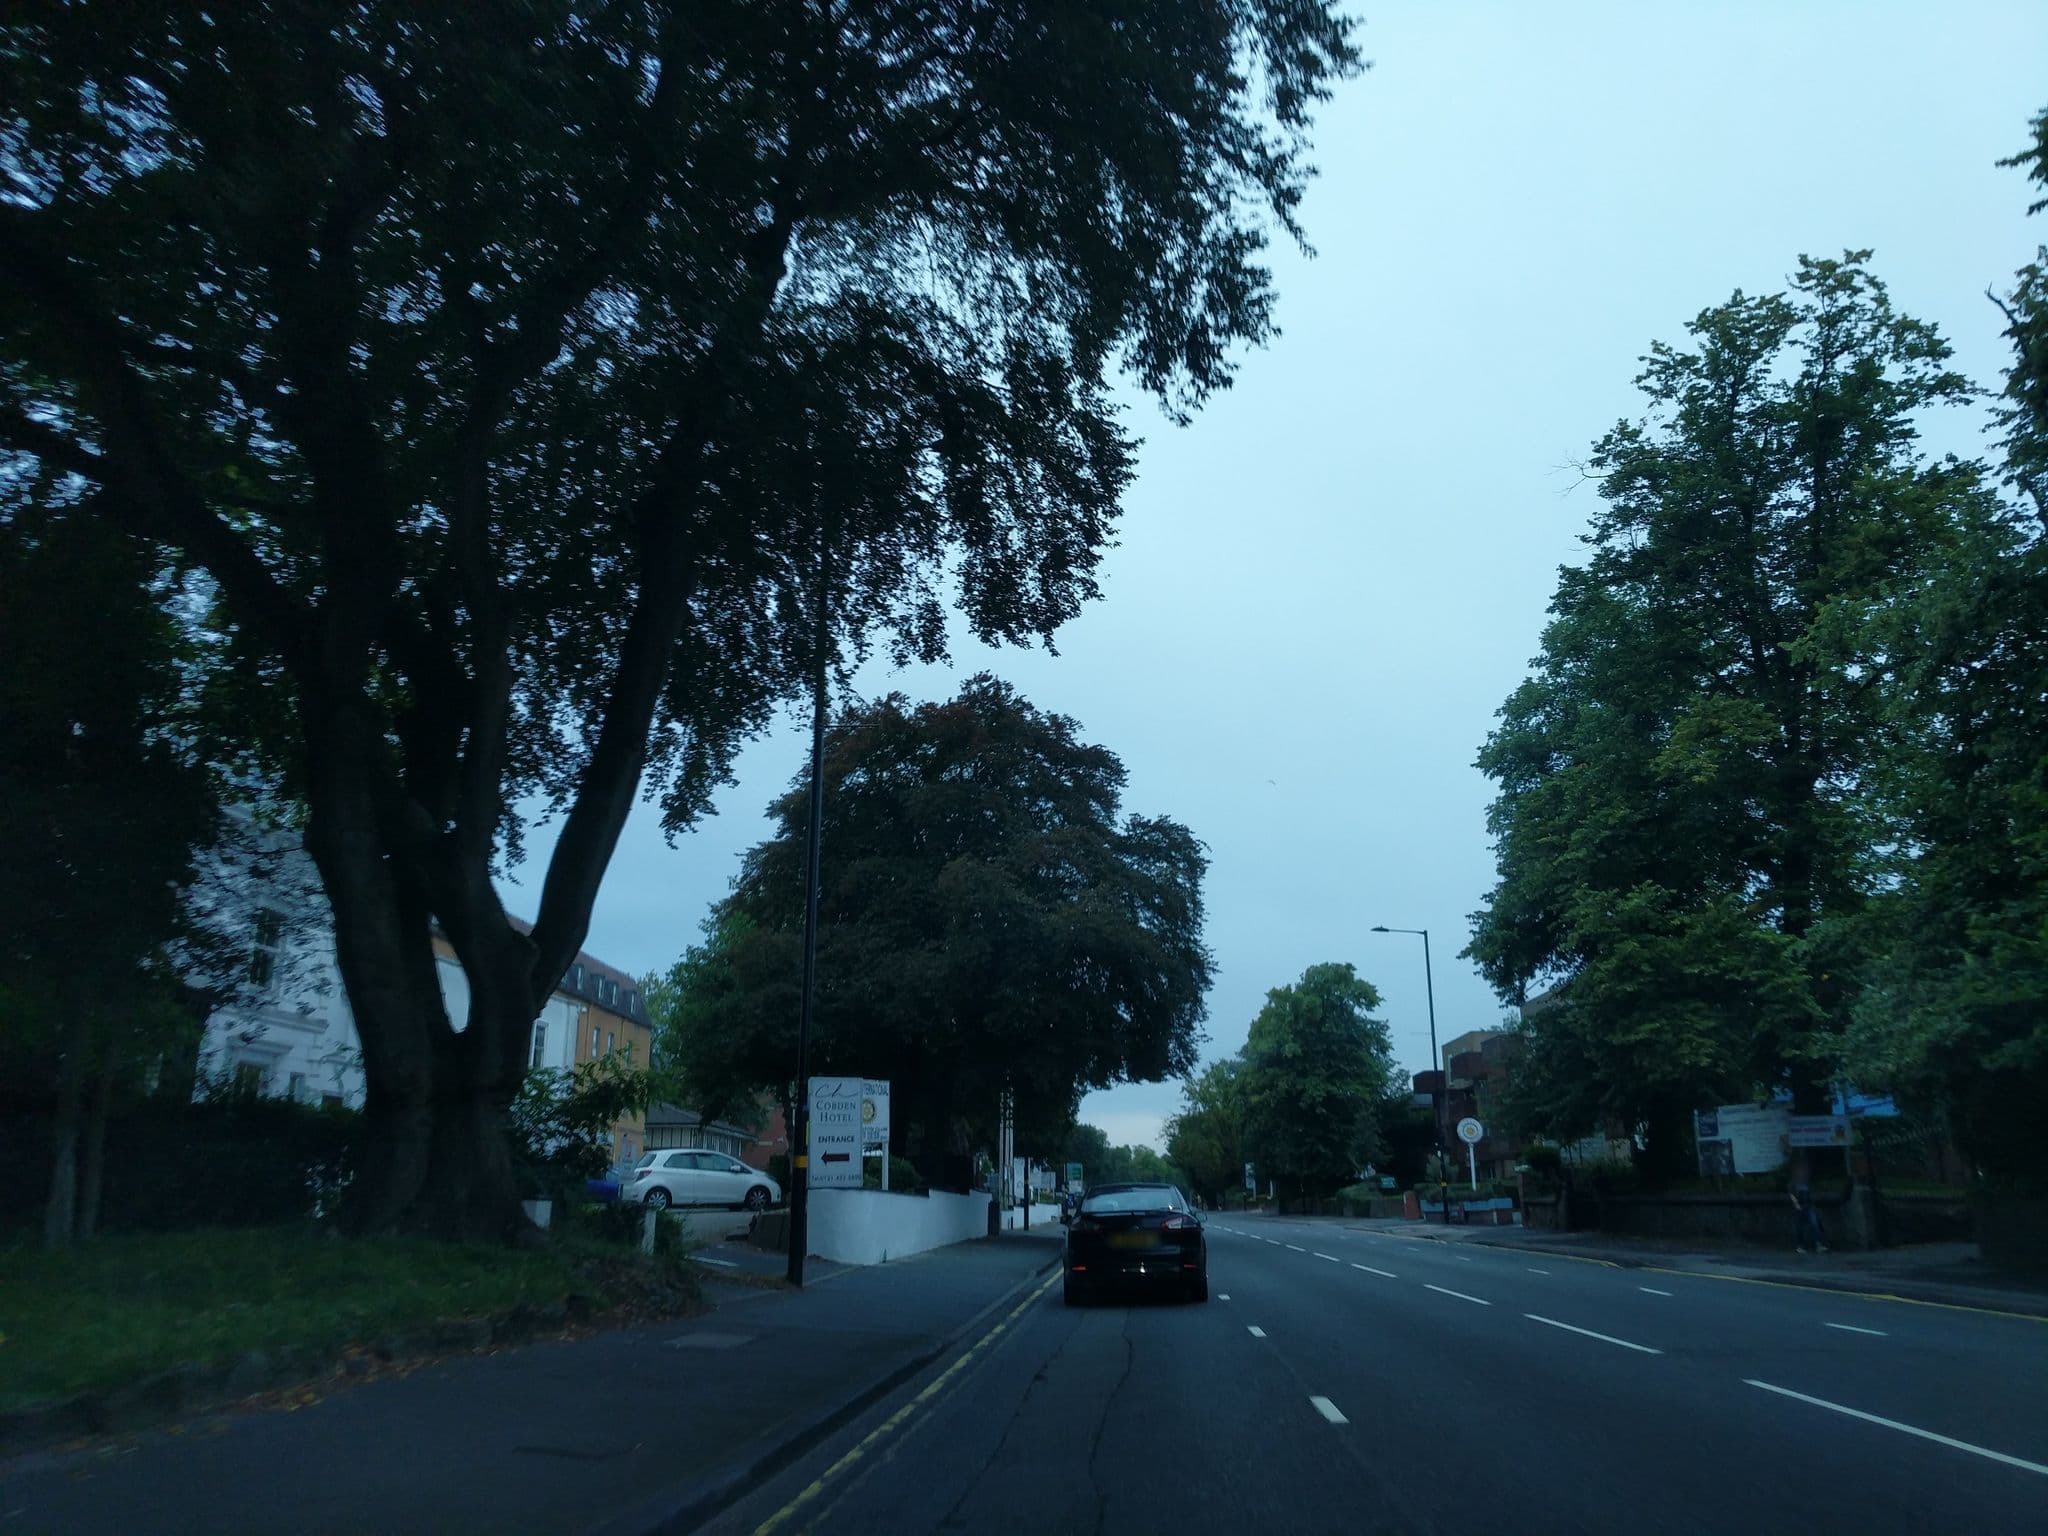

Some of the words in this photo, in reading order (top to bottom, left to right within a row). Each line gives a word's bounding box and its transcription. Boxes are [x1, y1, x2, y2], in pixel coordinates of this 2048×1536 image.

[816, 1101, 856, 1111] COBDEN
[820, 1112, 853, 1122] HOTEL
[818, 1135, 854, 1144] ENTRANCE
